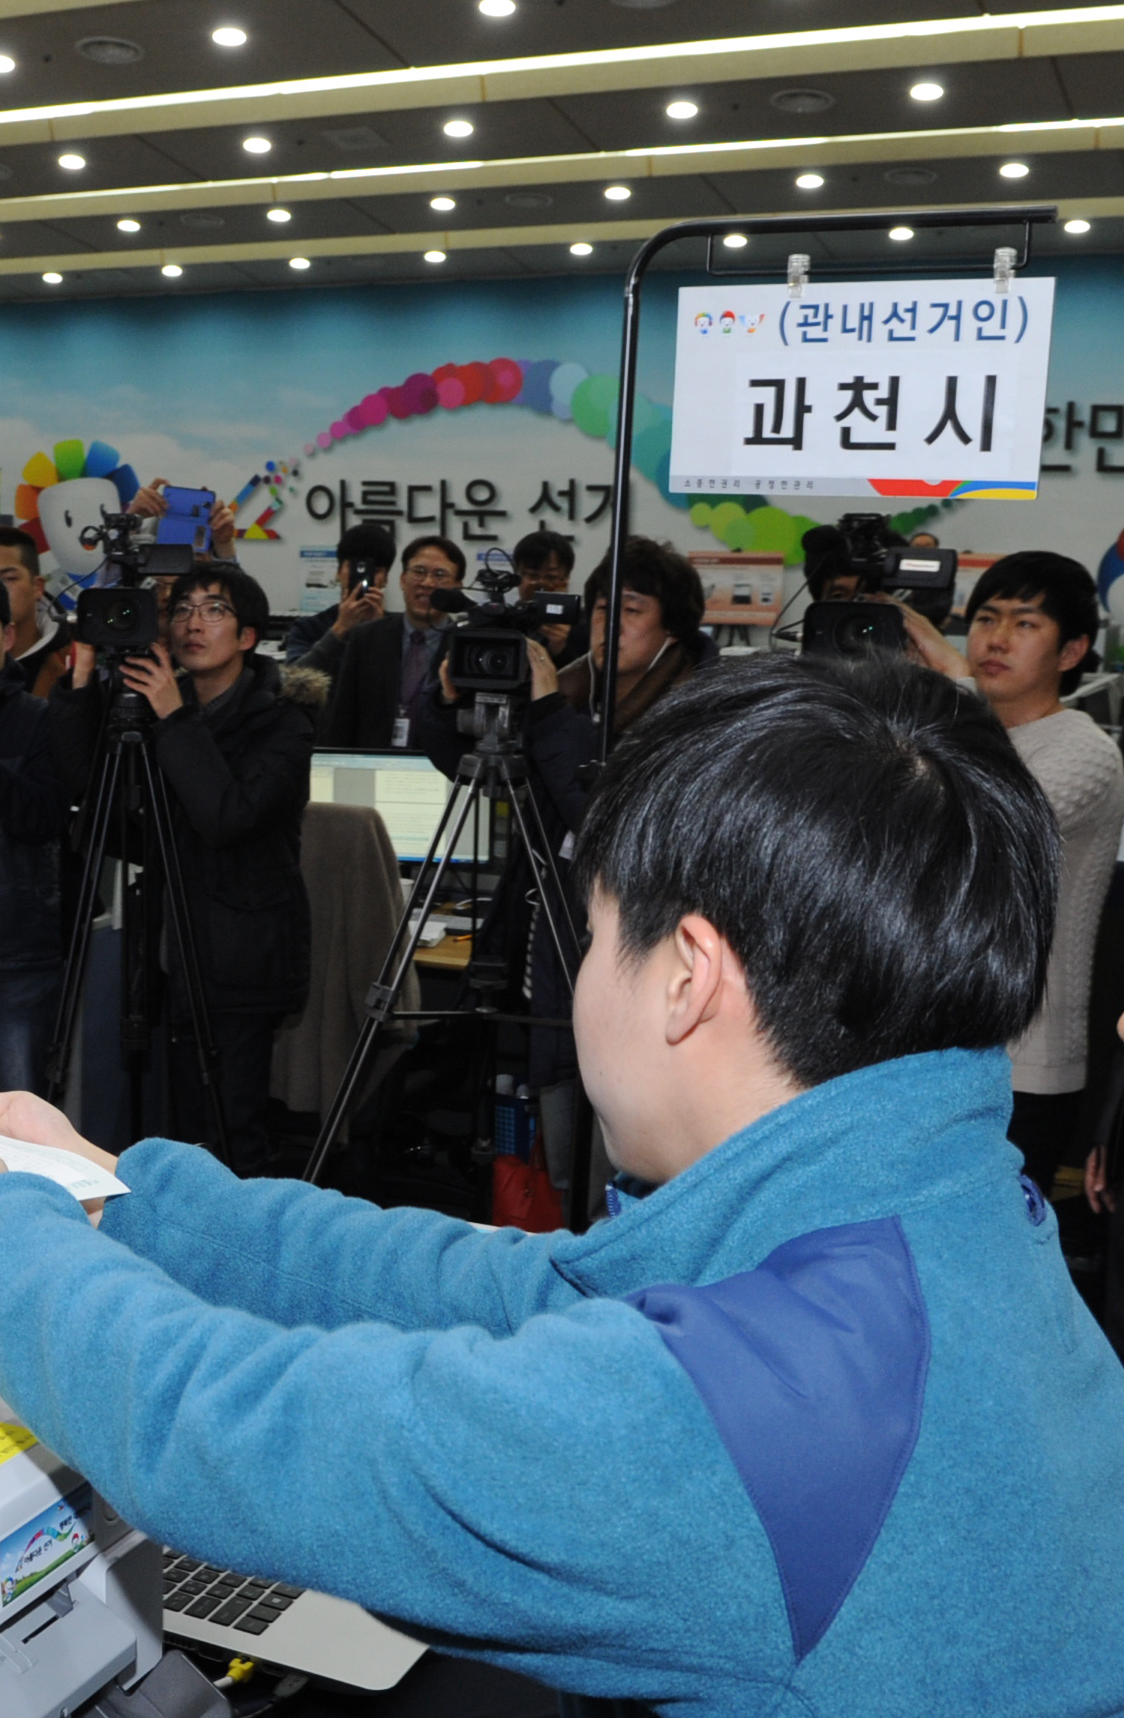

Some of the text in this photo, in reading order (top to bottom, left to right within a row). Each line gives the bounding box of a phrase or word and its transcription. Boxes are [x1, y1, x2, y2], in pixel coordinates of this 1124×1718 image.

[779, 296, 1029, 346] (관내선거인)
[743, 374, 997, 452] 과천시
[306, 479, 507, 542] 아름다운
